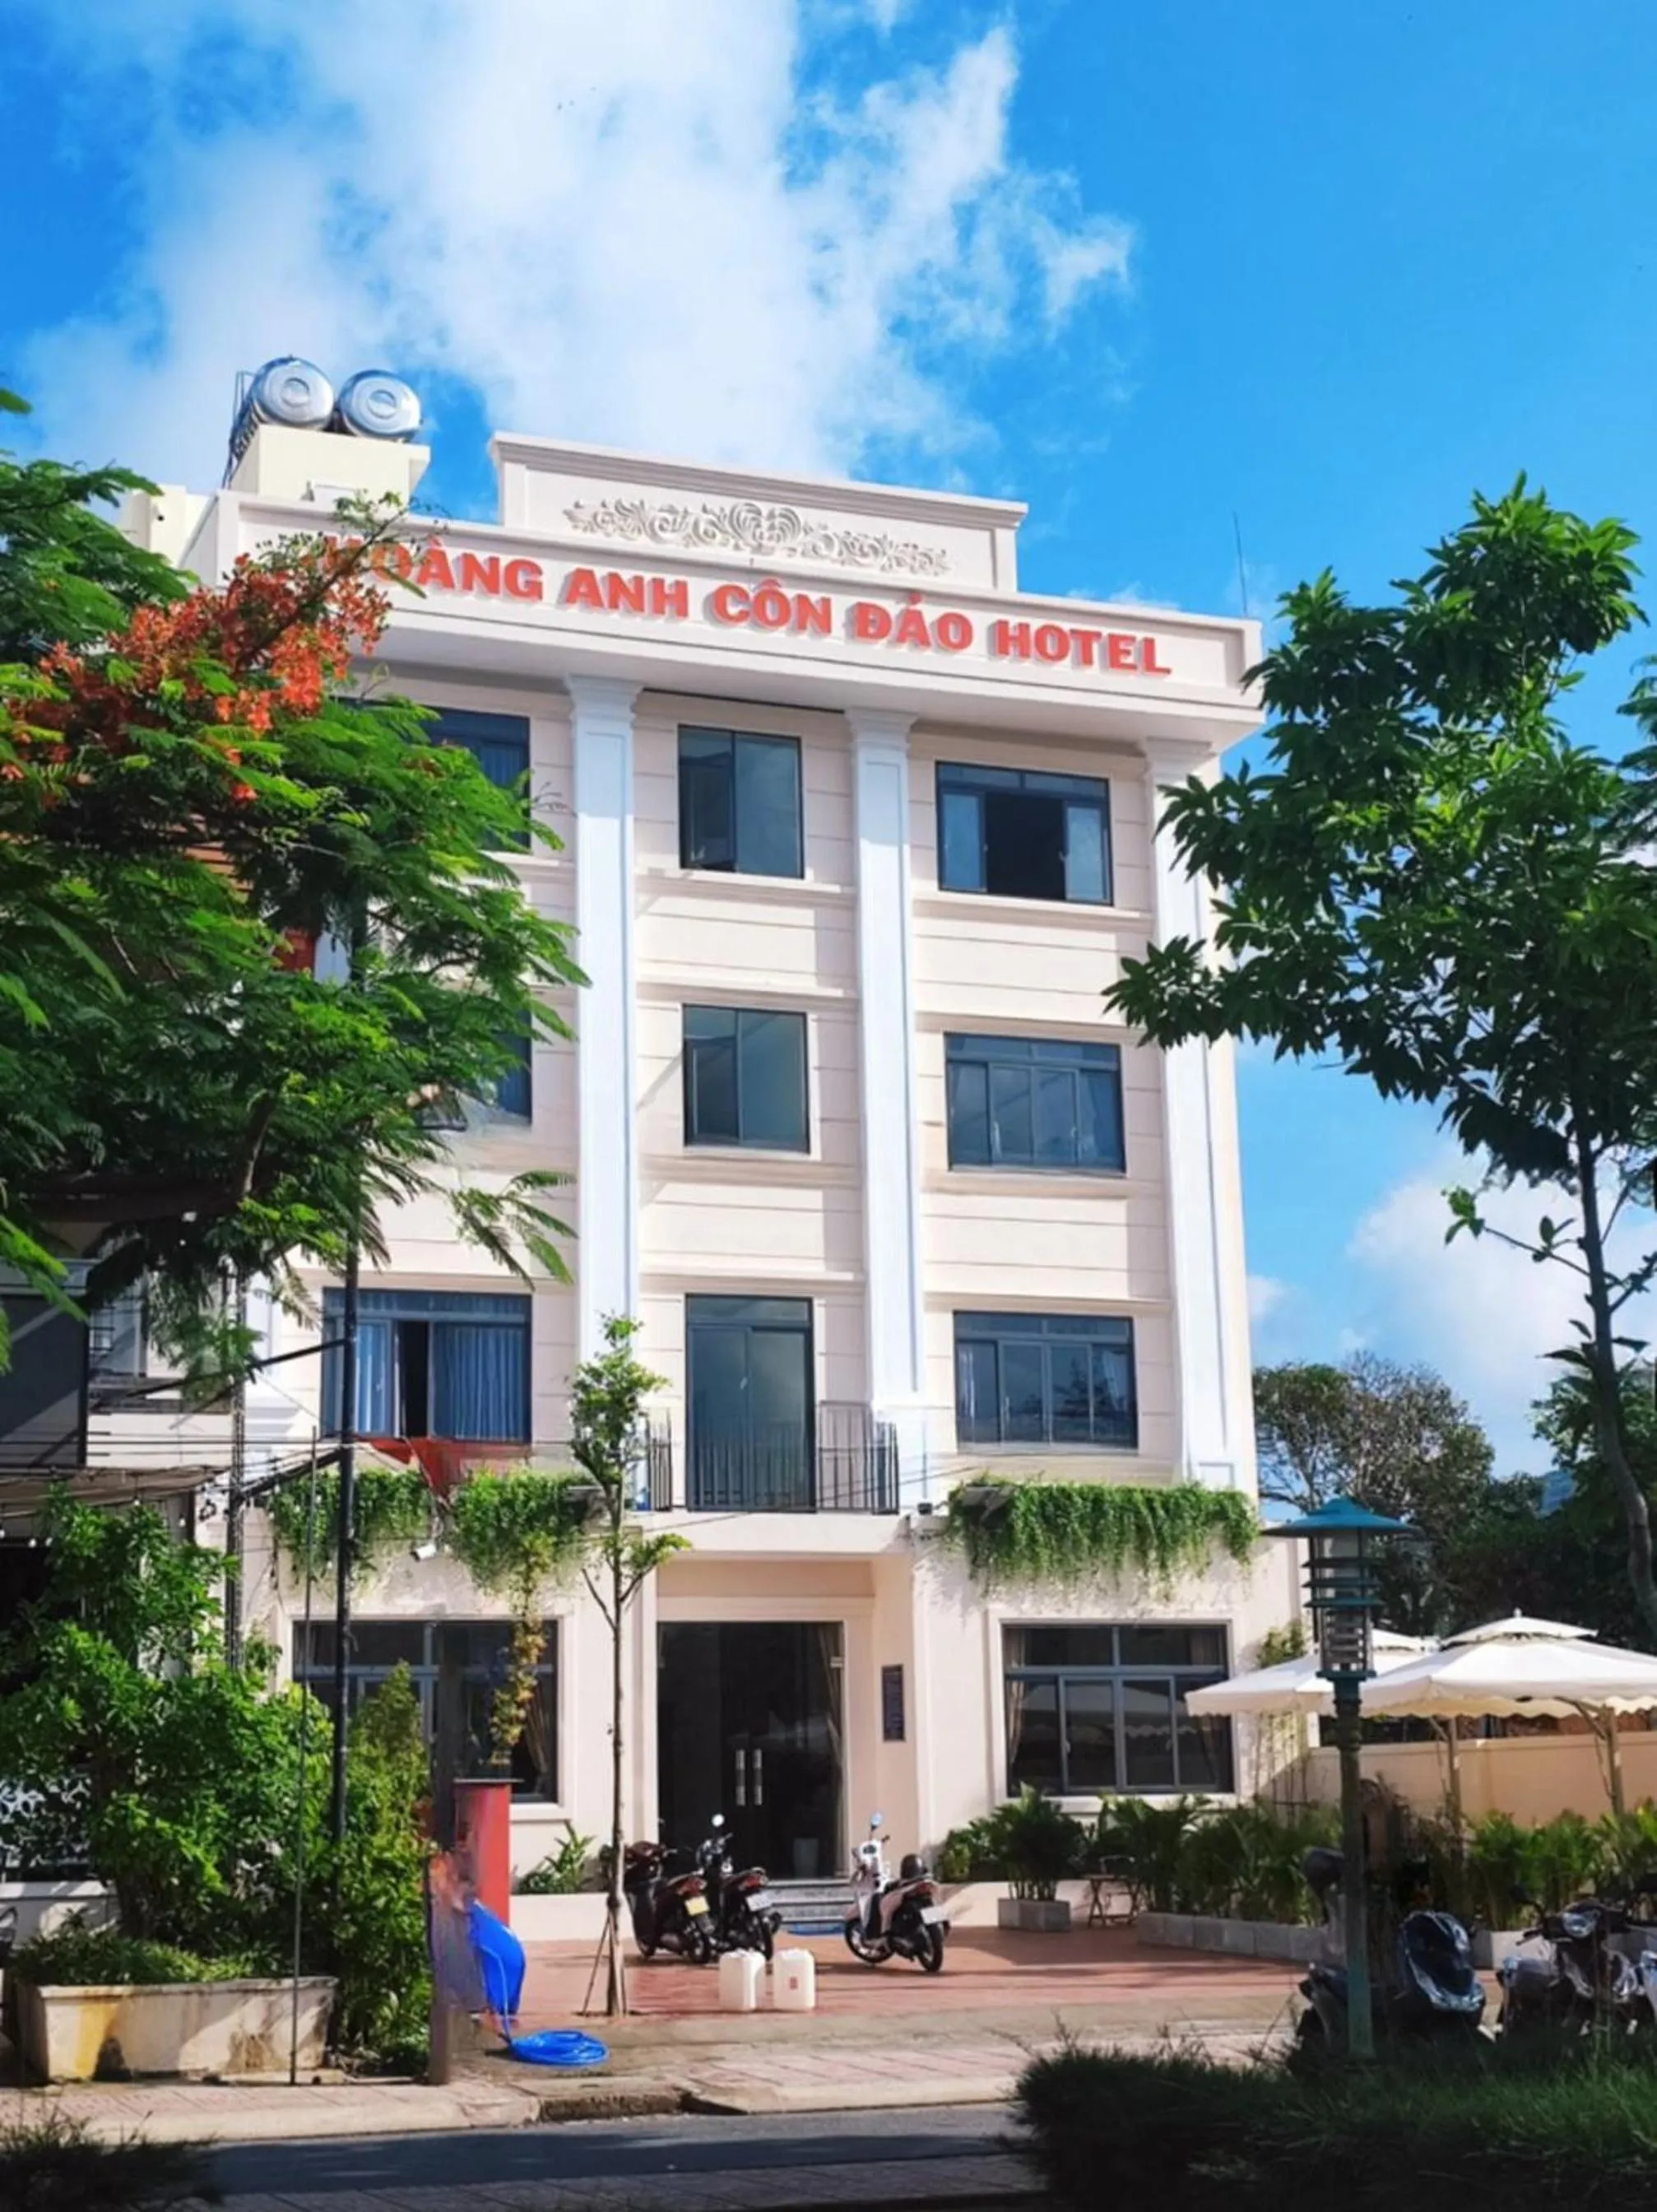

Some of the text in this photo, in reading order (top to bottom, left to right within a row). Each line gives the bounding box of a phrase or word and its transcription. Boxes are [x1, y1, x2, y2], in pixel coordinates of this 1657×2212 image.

[565, 568, 689, 619] ANH
[712, 576, 832, 634] CÔN
[853, 590, 973, 652] ĐẢO
[994, 619, 1172, 676] HOTEL
